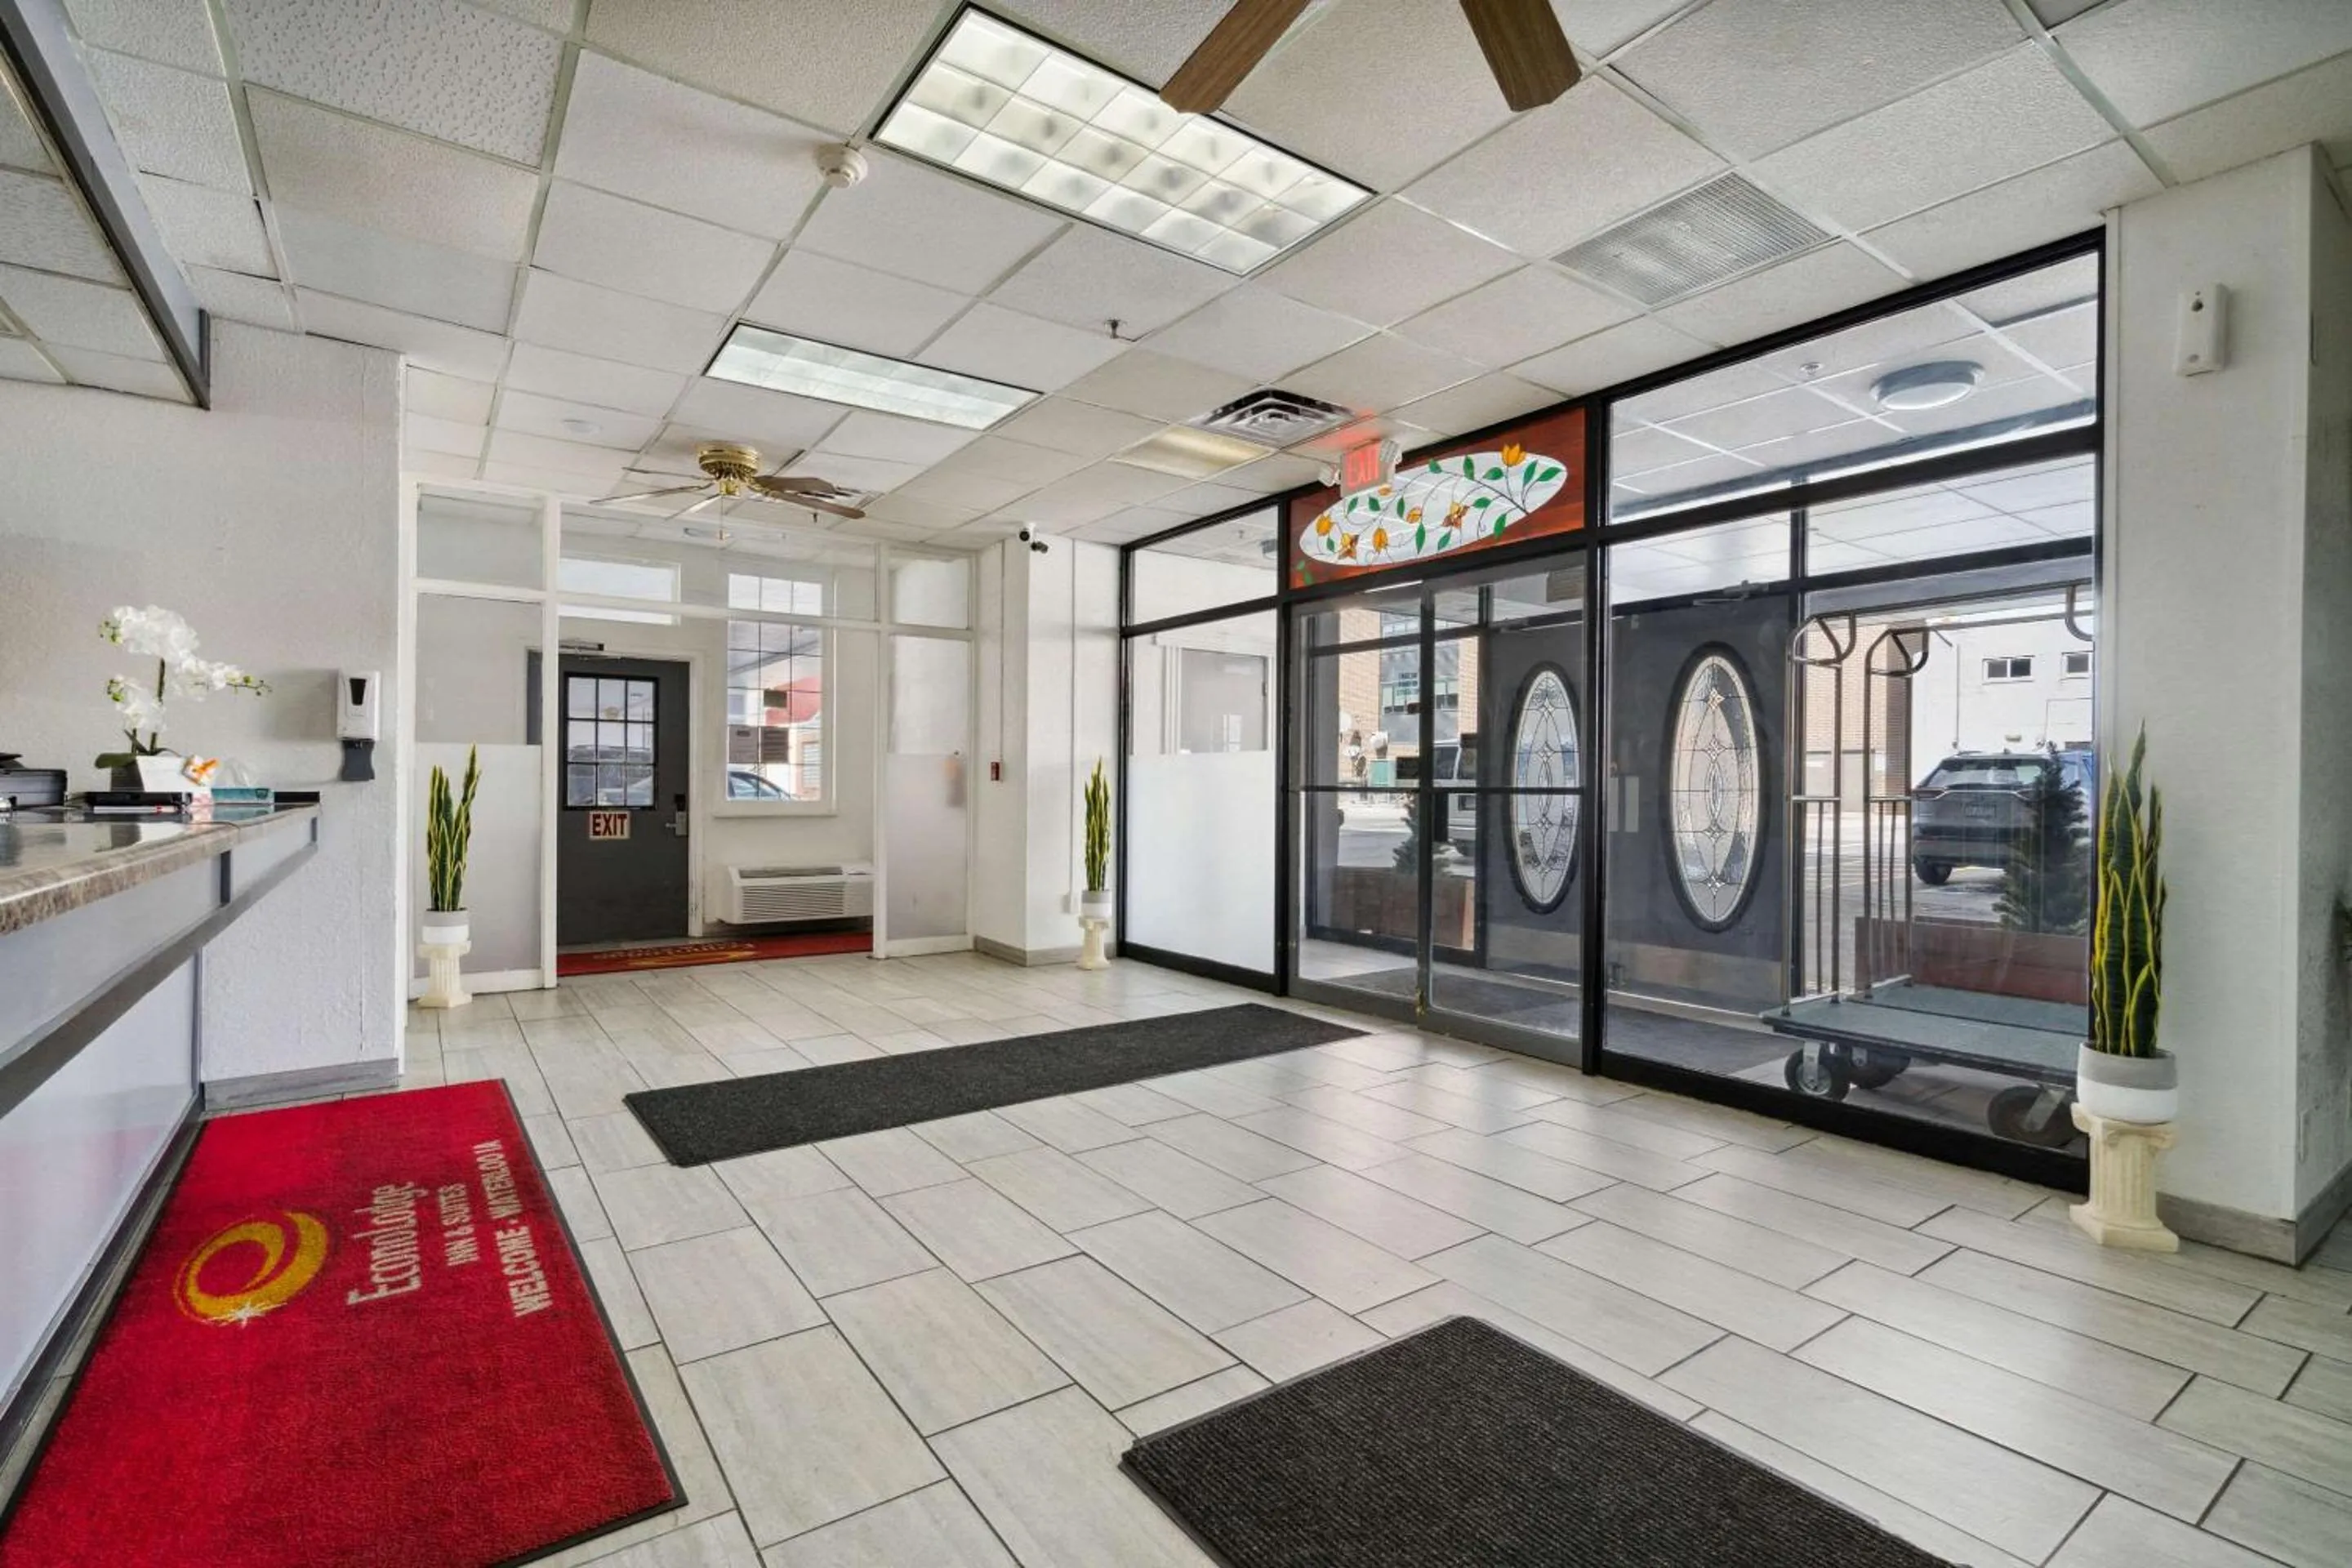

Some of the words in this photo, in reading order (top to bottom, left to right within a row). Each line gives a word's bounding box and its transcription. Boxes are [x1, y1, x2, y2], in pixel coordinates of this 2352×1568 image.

[592, 813, 628, 836] EXIT
[475, 1153, 523, 1219] WATERLOO
[438, 1183, 471, 1226] SUITES
[443, 1223, 474, 1238] &
[443, 1237, 480, 1266] INN
[495, 1226, 554, 1318] WELCOME
